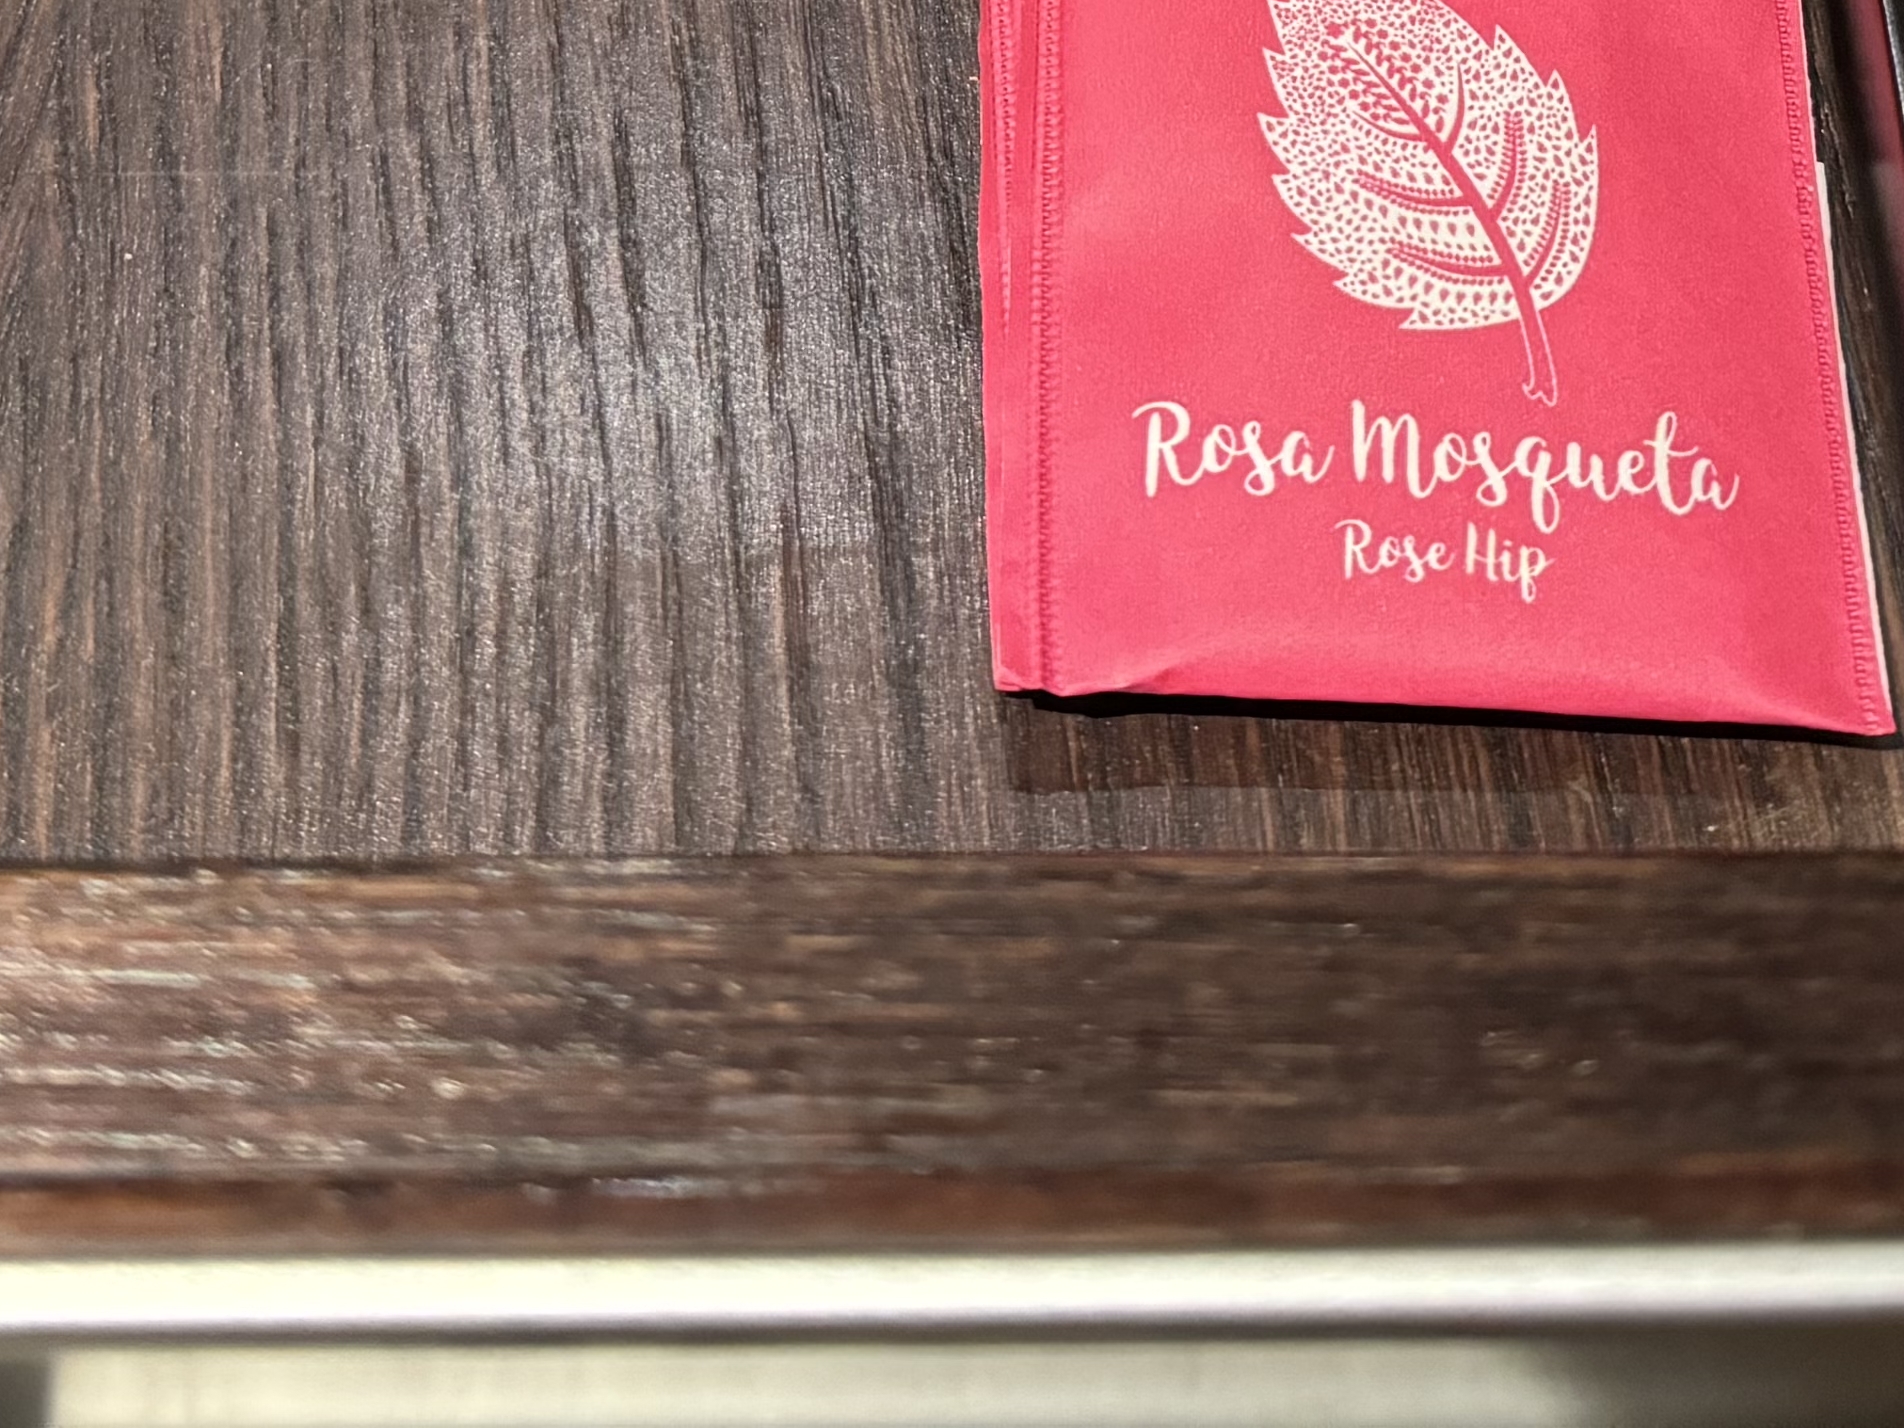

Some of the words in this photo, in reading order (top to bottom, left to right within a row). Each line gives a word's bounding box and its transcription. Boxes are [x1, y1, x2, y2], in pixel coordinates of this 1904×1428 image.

[1130, 400, 1335, 499] Rosa
[1350, 399, 1740, 534] Mosqueta
[1333, 518, 1454, 582] Rose
[1465, 524, 1554, 603] Hip
